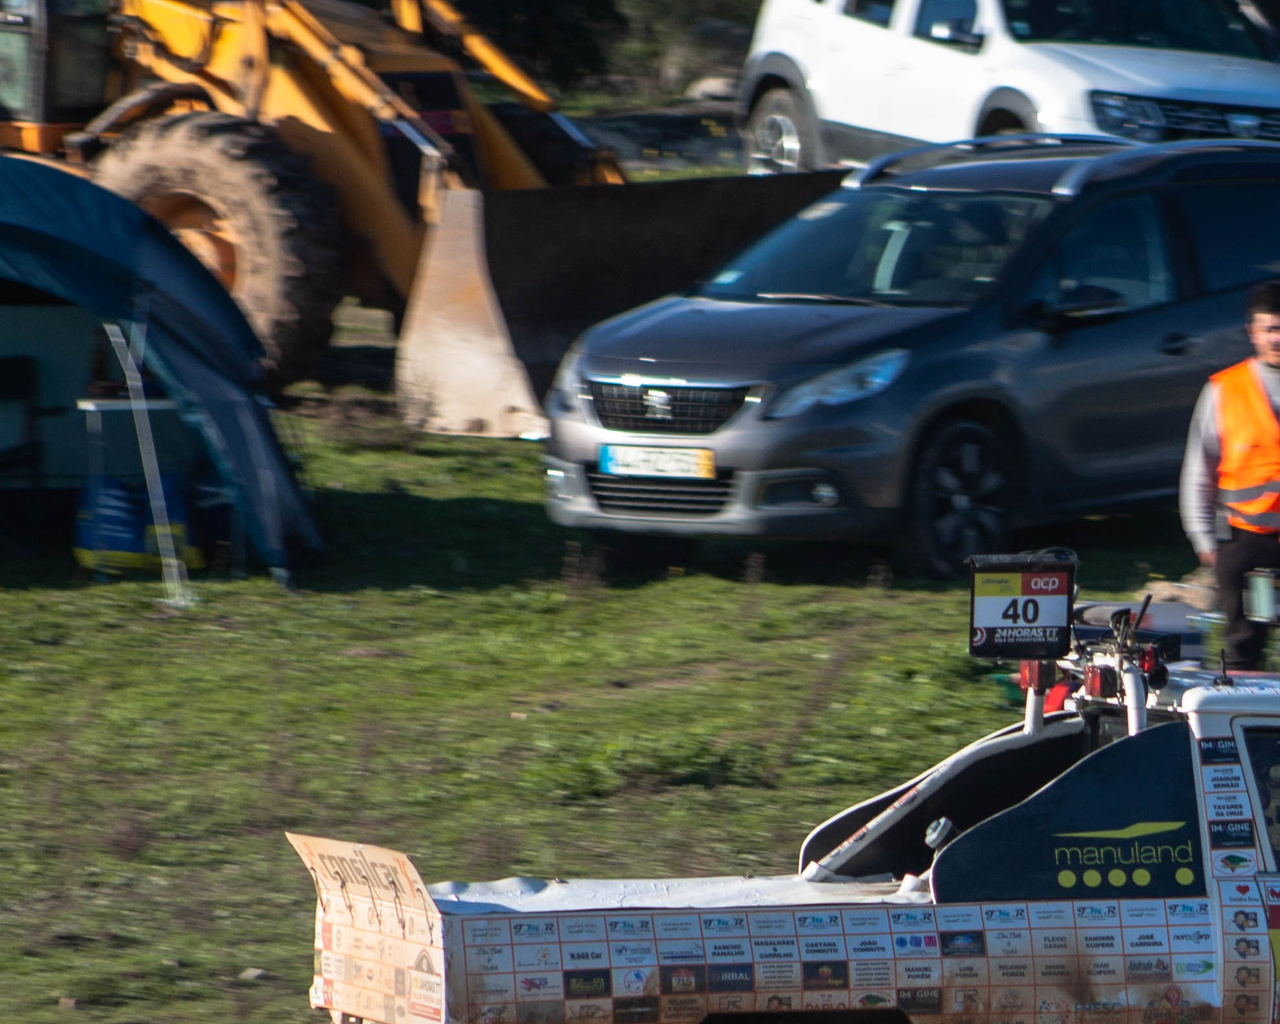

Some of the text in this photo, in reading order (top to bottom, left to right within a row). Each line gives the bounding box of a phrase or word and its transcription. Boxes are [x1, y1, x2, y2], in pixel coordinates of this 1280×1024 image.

[1031, 577, 1059, 591] acp
[1001, 598, 1039, 625] 40
[1055, 840, 1193, 866] manuland
